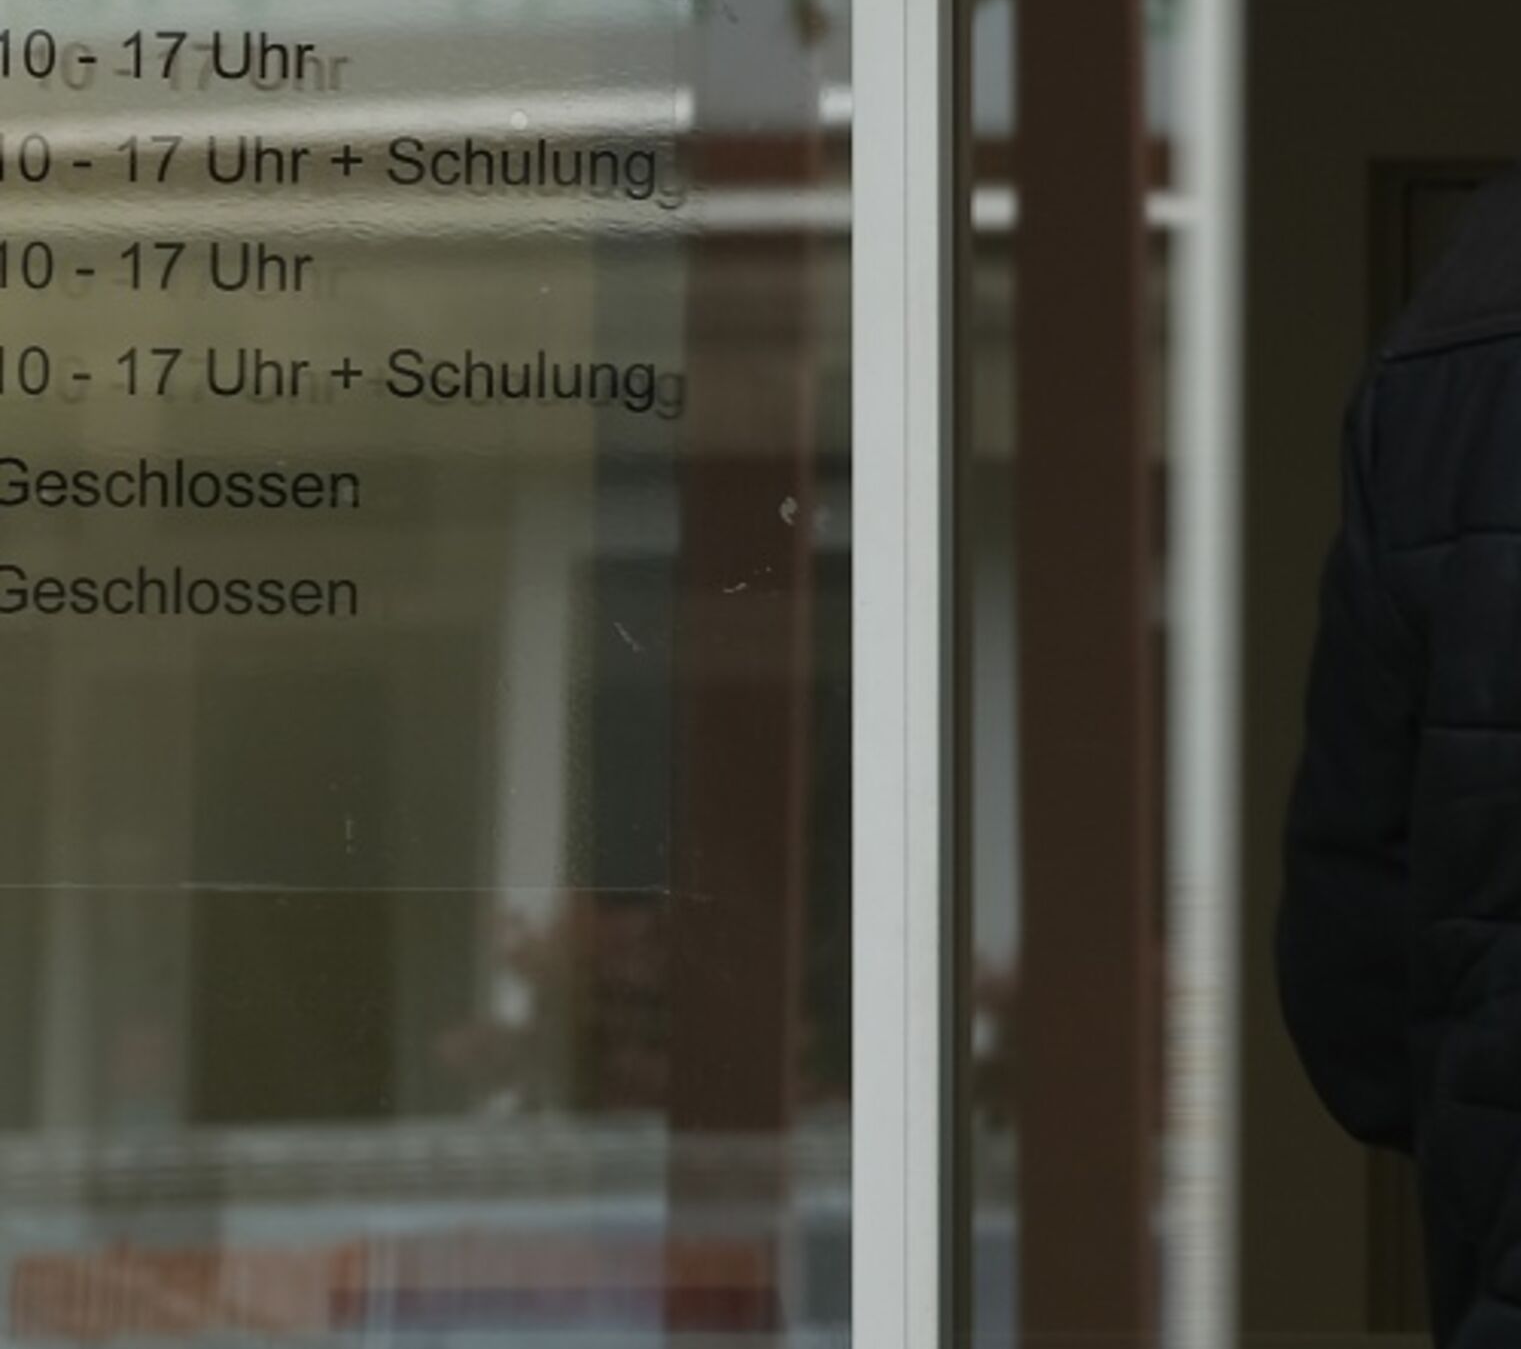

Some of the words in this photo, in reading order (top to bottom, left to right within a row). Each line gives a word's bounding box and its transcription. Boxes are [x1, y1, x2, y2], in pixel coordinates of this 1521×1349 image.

[0, 28, 56, 79] 10
[122, 29, 188, 79] 17
[213, 30, 315, 80] Uhr
[117, 134, 183, 184] 17
[207, 135, 310, 185] Uhr
[387, 136, 656, 200] Schulung
[120, 241, 187, 290] 17
[210, 242, 314, 292] Uhr
[117, 347, 183, 396] 17
[207, 348, 310, 397] Uhr
[386, 348, 656, 413] Schulung
[0, 457, 361, 509] Geschlossen
[0, 564, 358, 616] Geschlossen
